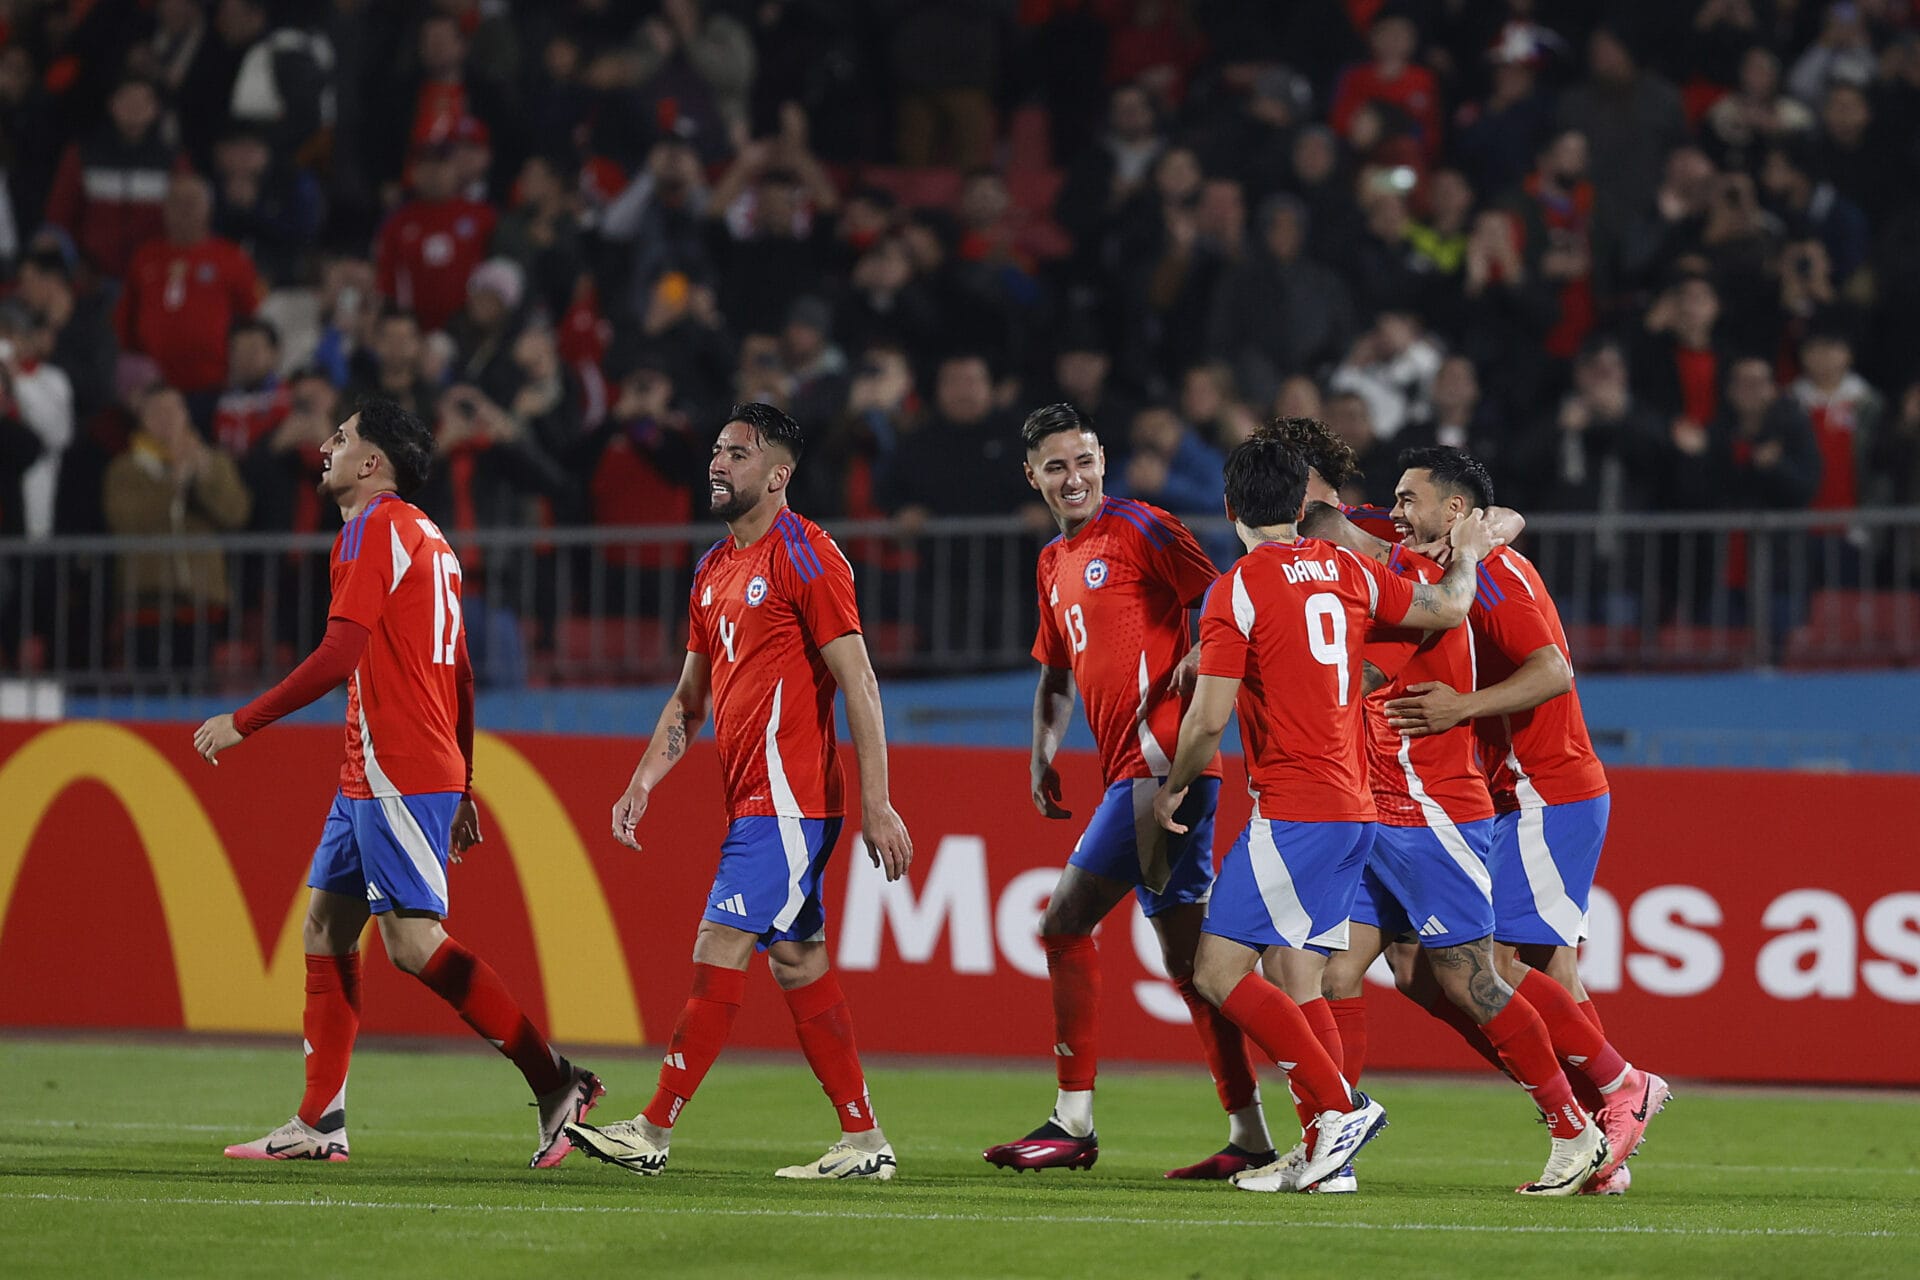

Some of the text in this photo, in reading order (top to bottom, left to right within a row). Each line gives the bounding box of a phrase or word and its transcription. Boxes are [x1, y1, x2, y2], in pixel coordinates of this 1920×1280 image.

[1281, 556, 1339, 584] DÁVILA
[720, 614, 735, 662] 4
[1064, 603, 1088, 655] 13
[1305, 592, 1349, 706] 9
